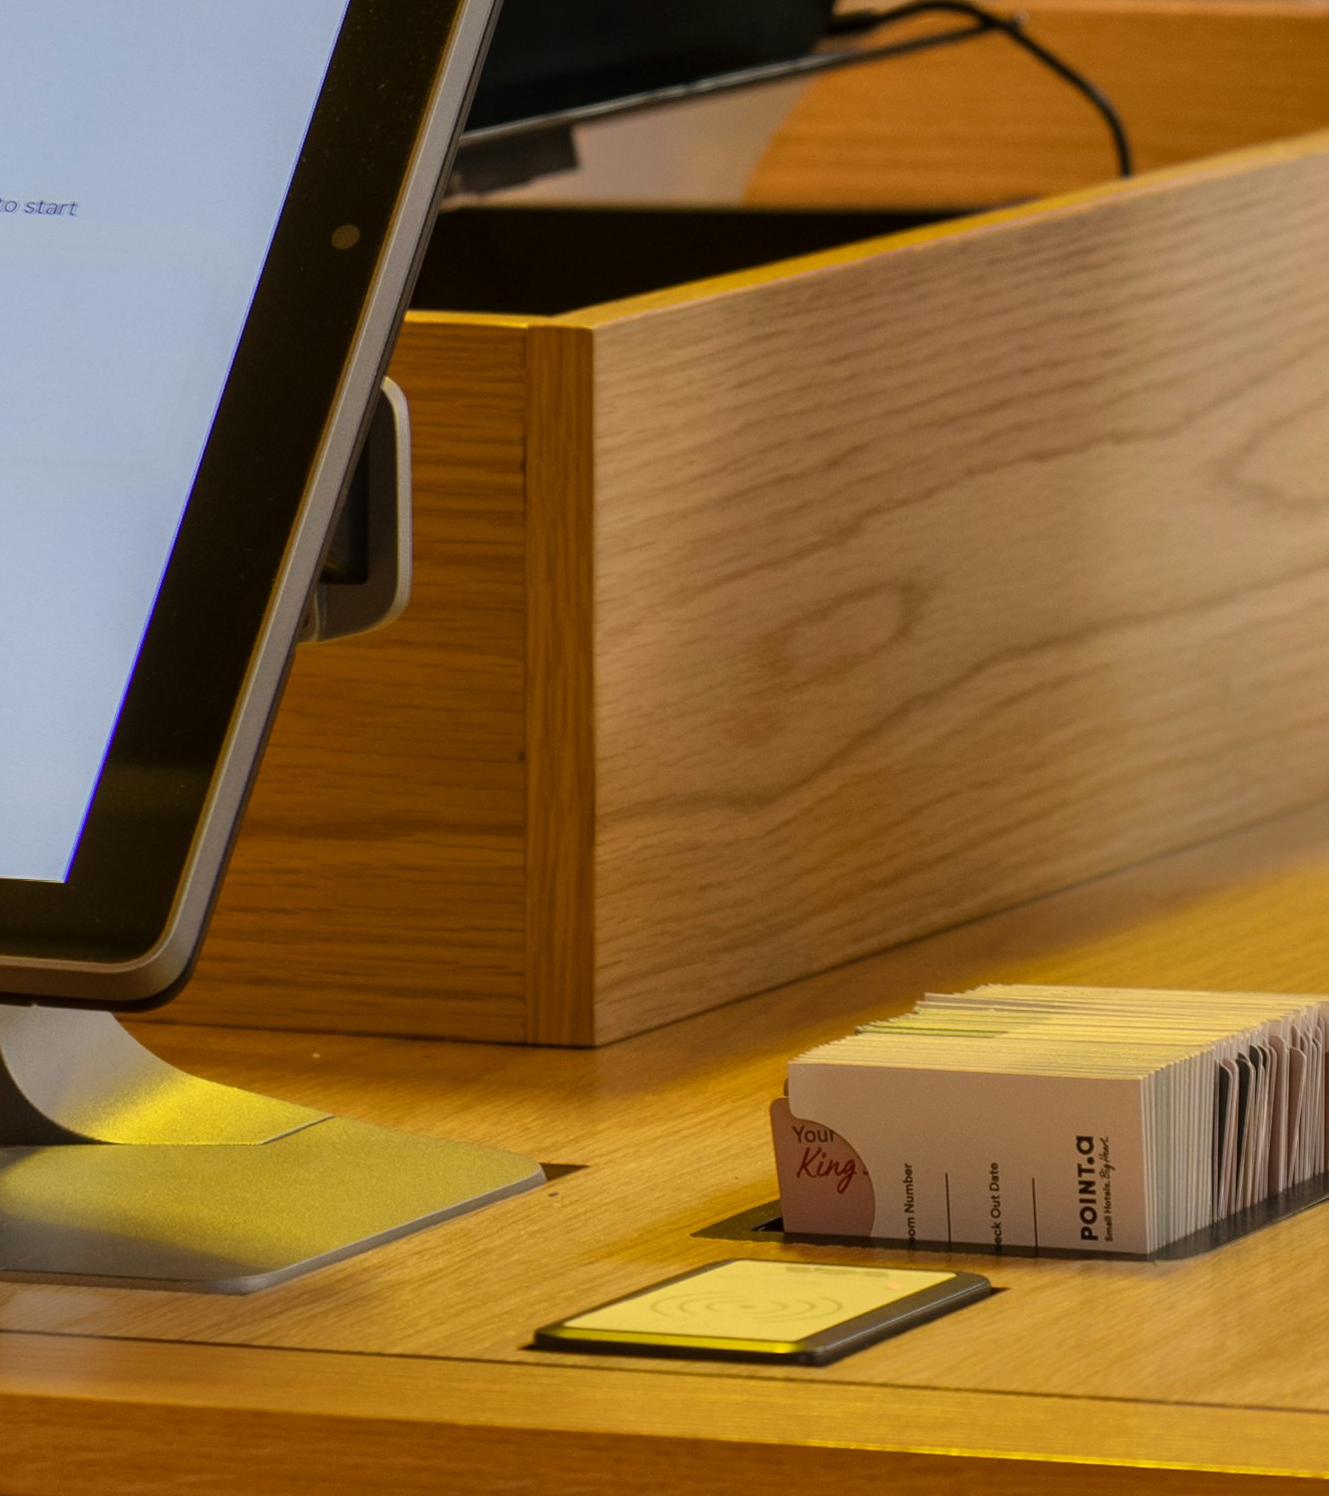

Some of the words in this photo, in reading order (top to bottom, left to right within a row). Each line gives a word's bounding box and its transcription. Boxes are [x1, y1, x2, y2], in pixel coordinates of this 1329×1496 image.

[23, 199, 79, 217] start
[792, 1125, 835, 1144] Your
[796, 1147, 858, 1194] King
[989, 1162, 1001, 1192] Date
[903, 1163, 916, 1214] Number
[990, 1195, 1002, 1219] Out
[907, 1217, 917, 1242] oom
[990, 1222, 1003, 1245] eck
[1104, 1216, 1114, 1242] Small
